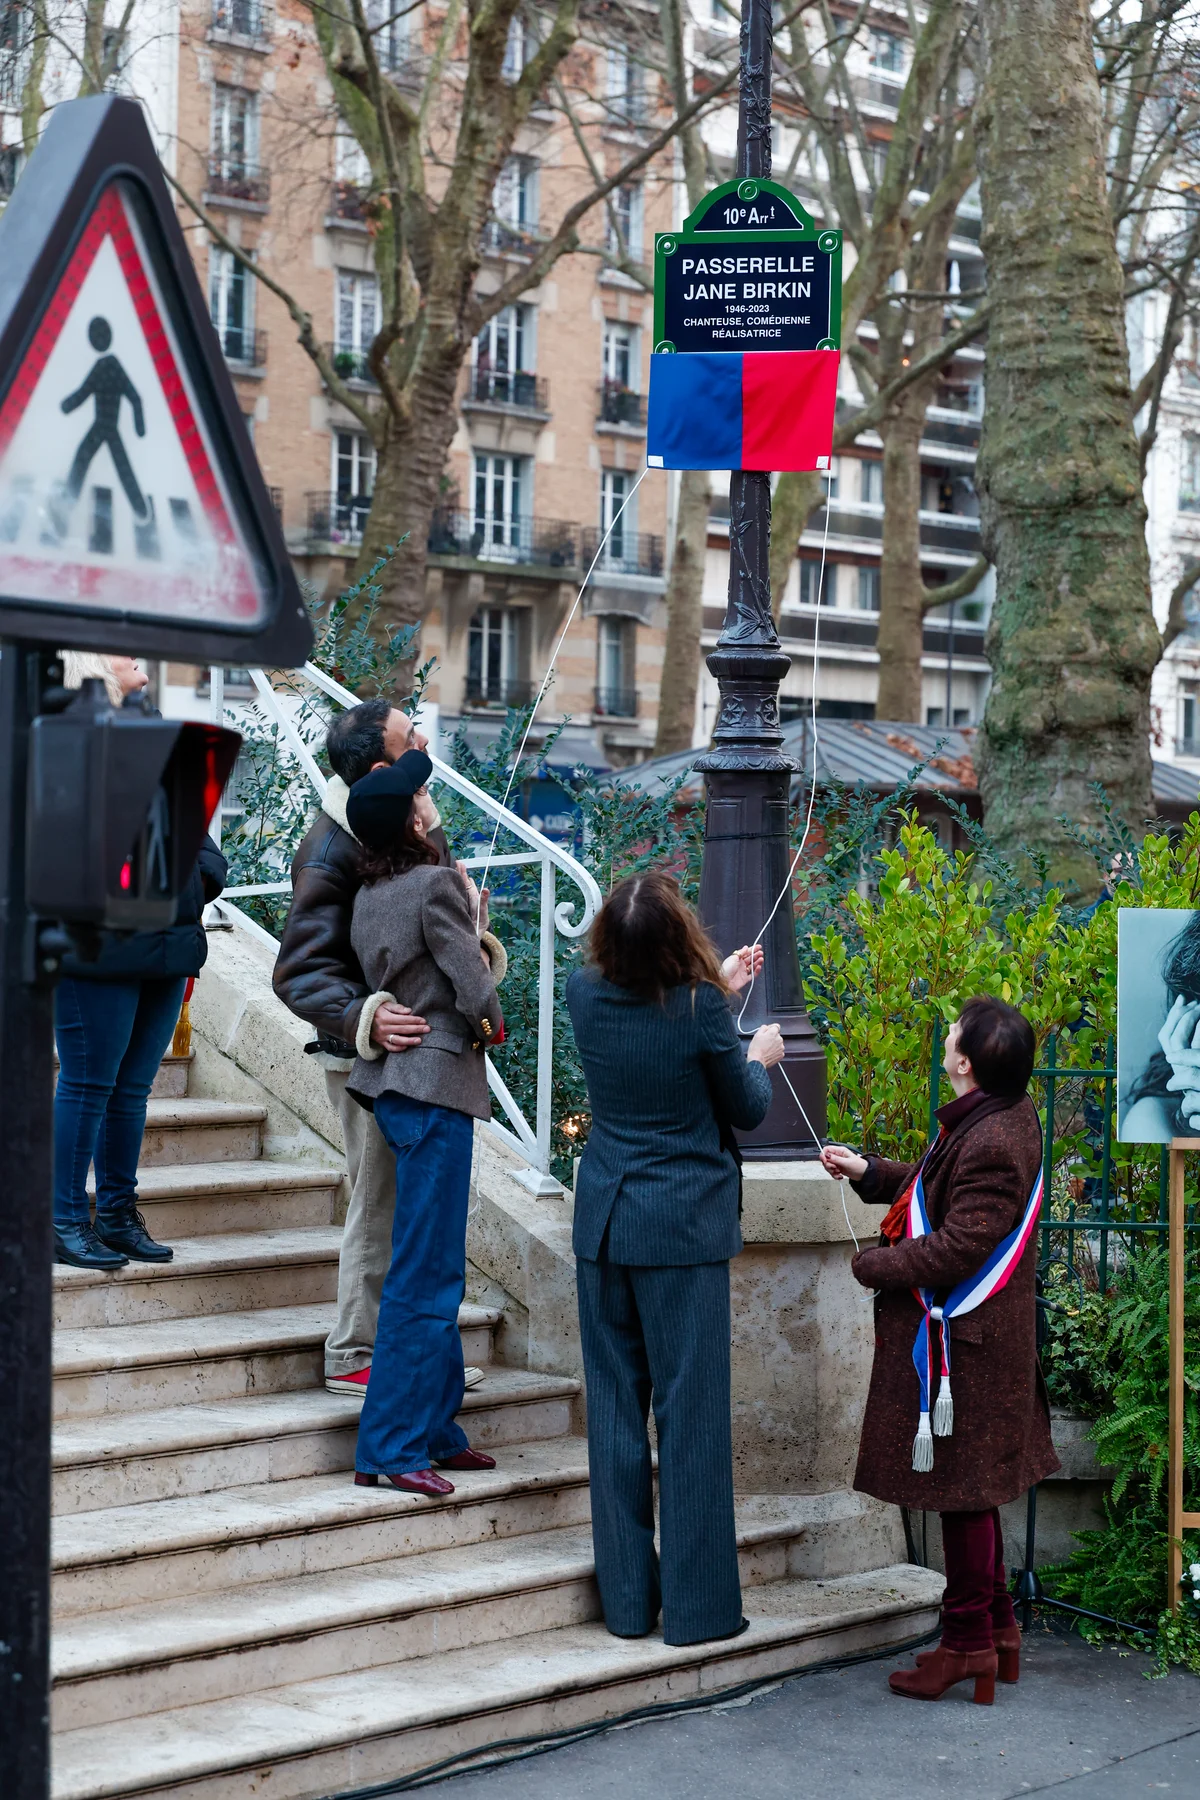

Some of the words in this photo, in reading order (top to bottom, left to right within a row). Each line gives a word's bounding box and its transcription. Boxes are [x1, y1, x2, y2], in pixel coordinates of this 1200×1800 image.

[723, 207, 746, 225] 10e
[682, 256, 815, 275] PASSERELLE
[683, 283, 737, 300] JANE
[742, 282, 811, 299] BIRKIN
[724, 304, 770, 313] 1946-2023
[683, 317, 745, 327] CHANTEUSE,
[746, 315, 811, 326] COMÉDIENNE
[711, 328, 782, 339] RÉALISATRICE
